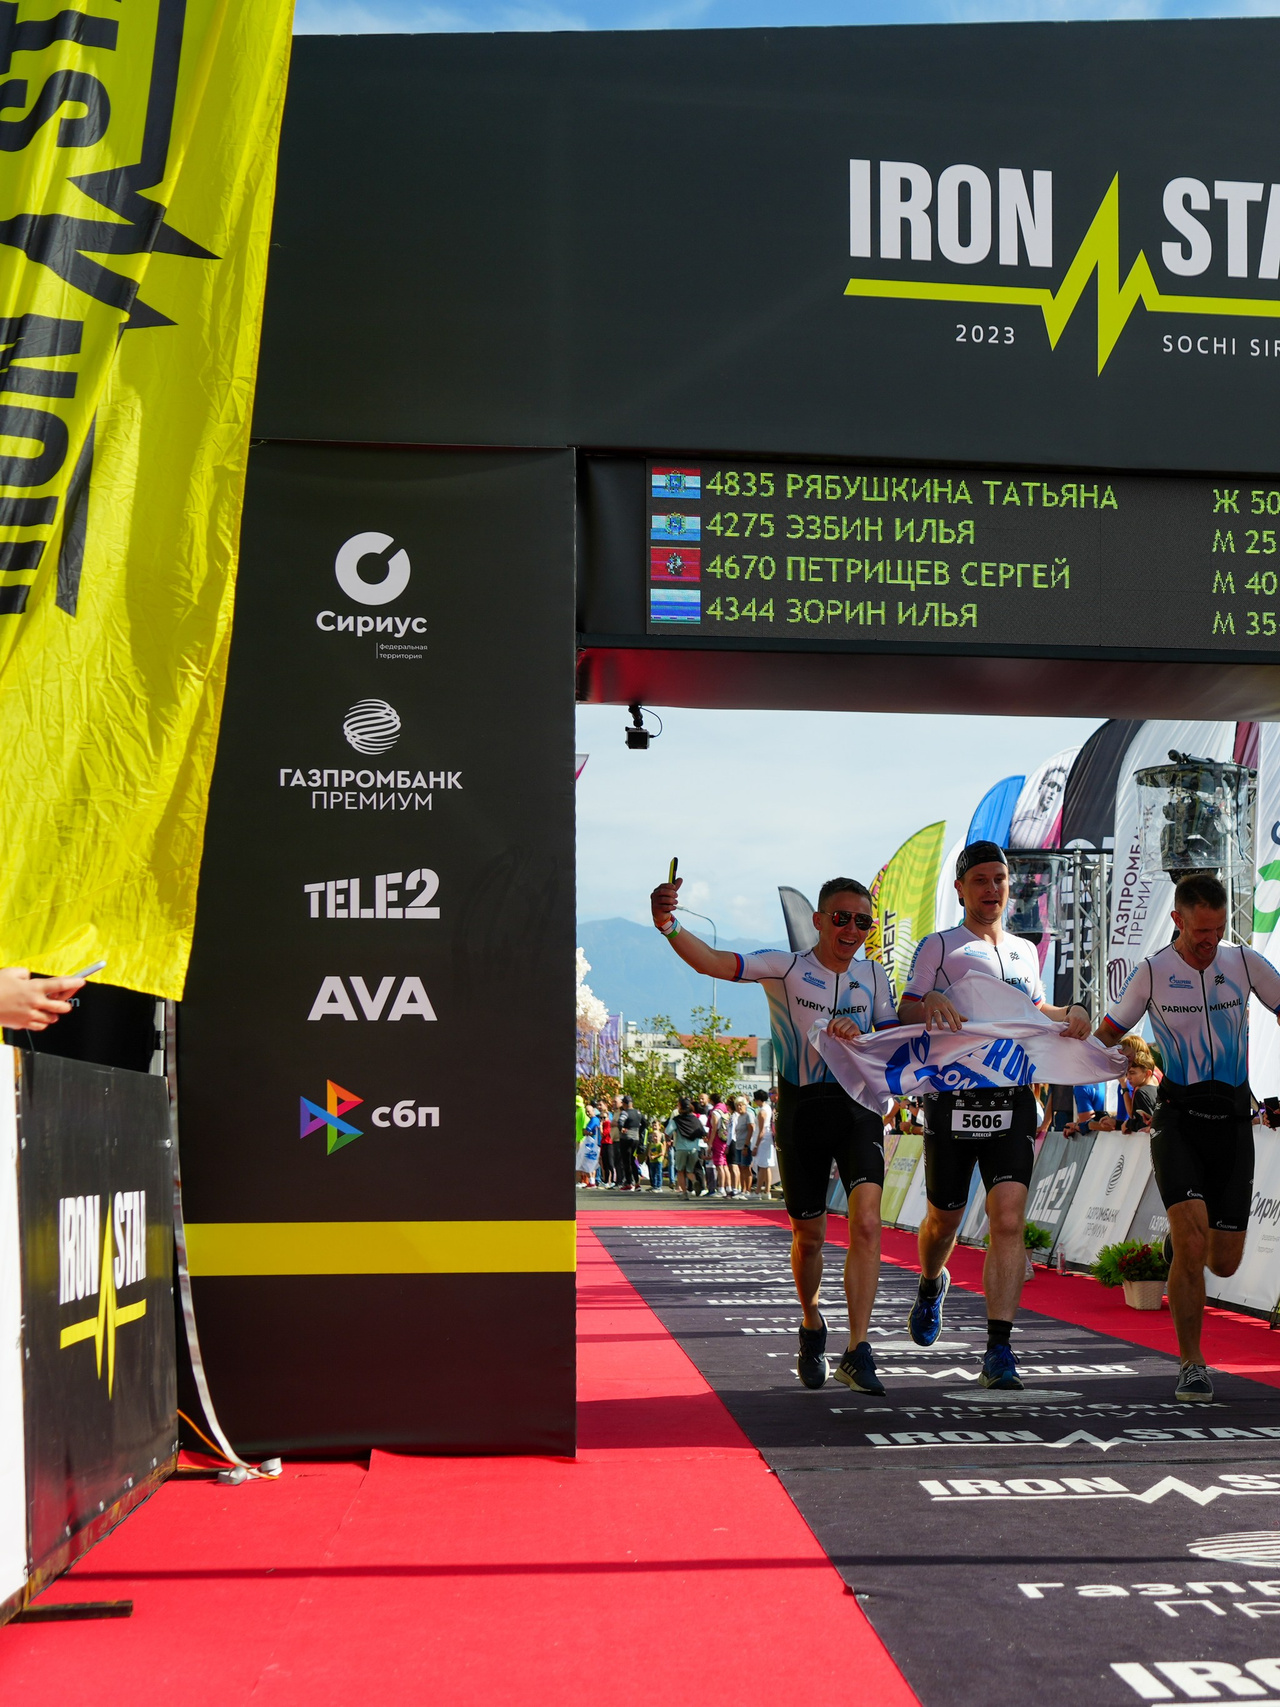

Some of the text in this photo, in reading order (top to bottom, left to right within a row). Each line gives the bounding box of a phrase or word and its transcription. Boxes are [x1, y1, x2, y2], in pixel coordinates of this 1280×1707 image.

[850, 159, 1053, 267] IRON
[955, 324, 1016, 344] 2023
[1163, 335, 1236, 355] SOCHI
[706, 471, 775, 498] 4835
[786, 474, 973, 505] РЯБУШКИНА
[982, 480, 1118, 510] ТАТЬЯНА
[1213, 489, 1240, 514] Ж
[706, 512, 775, 538] 4275
[786, 515, 882, 541] ЭЗБИН
[895, 518, 975, 545] ИЛЬЯ
[1212, 529, 1235, 553] М
[706, 555, 776, 580] 4670
[786, 556, 950, 591] ПЕТРИЩЕВ
[961, 558, 1071, 590] СЕРГЕЙ
[1212, 570, 1235, 595] М
[316, 610, 428, 637] Сириус
[706, 597, 775, 622] 4344
[786, 599, 886, 625] ЗОРИН
[898, 601, 978, 628] ИЛЬЯ
[1212, 611, 1235, 635] М
[379, 643, 428, 651] федеральная
[279, 769, 463, 790] ГАЗПРОМБАНК
[312, 791, 433, 811] ПРЕМИУМ
[304, 868, 440, 919] TELE2
[307, 976, 438, 1021] AVA
[795, 996, 868, 1016] YURIY VANEEV
[1161, 998, 1243, 1013] PARINOV MIKHAIL
[371, 1100, 440, 1127] сбп
[962, 1113, 1002, 1129] 5606
[59, 1195, 100, 1306] IRON
[865, 1430, 1044, 1445] IRON
[919, 1477, 1130, 1496] IRON
